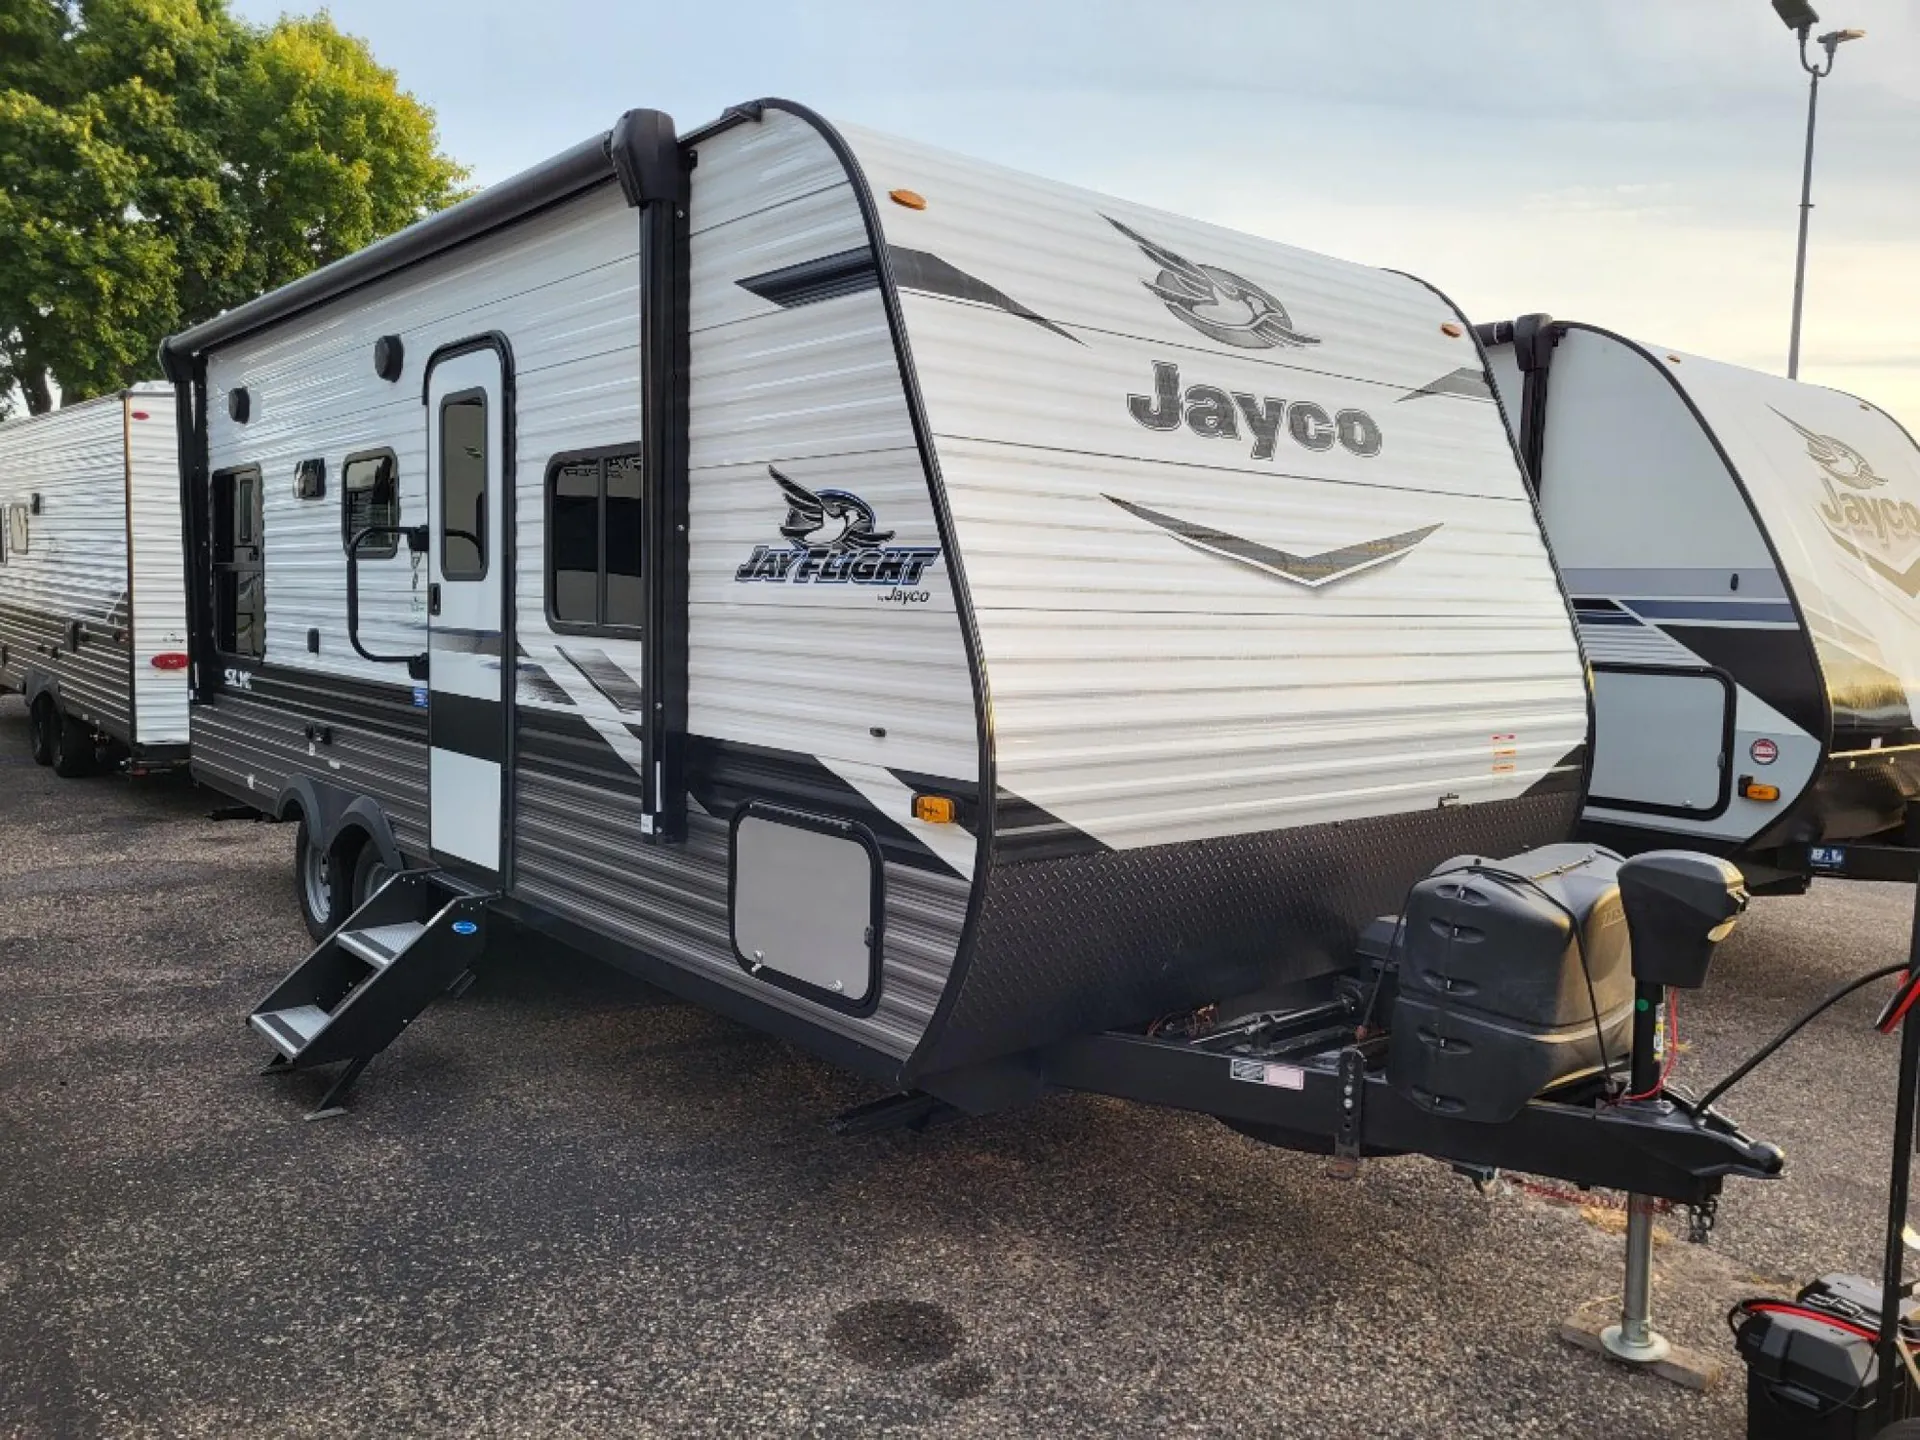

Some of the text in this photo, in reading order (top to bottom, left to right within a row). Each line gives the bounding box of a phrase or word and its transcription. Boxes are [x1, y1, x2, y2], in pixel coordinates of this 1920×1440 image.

[1126, 361, 1383, 461] Jayco
[1820, 477, 1920, 539] Jayco
[735, 545, 942, 585] JAY FLIGHT
[885, 586, 930, 605] Jayco
